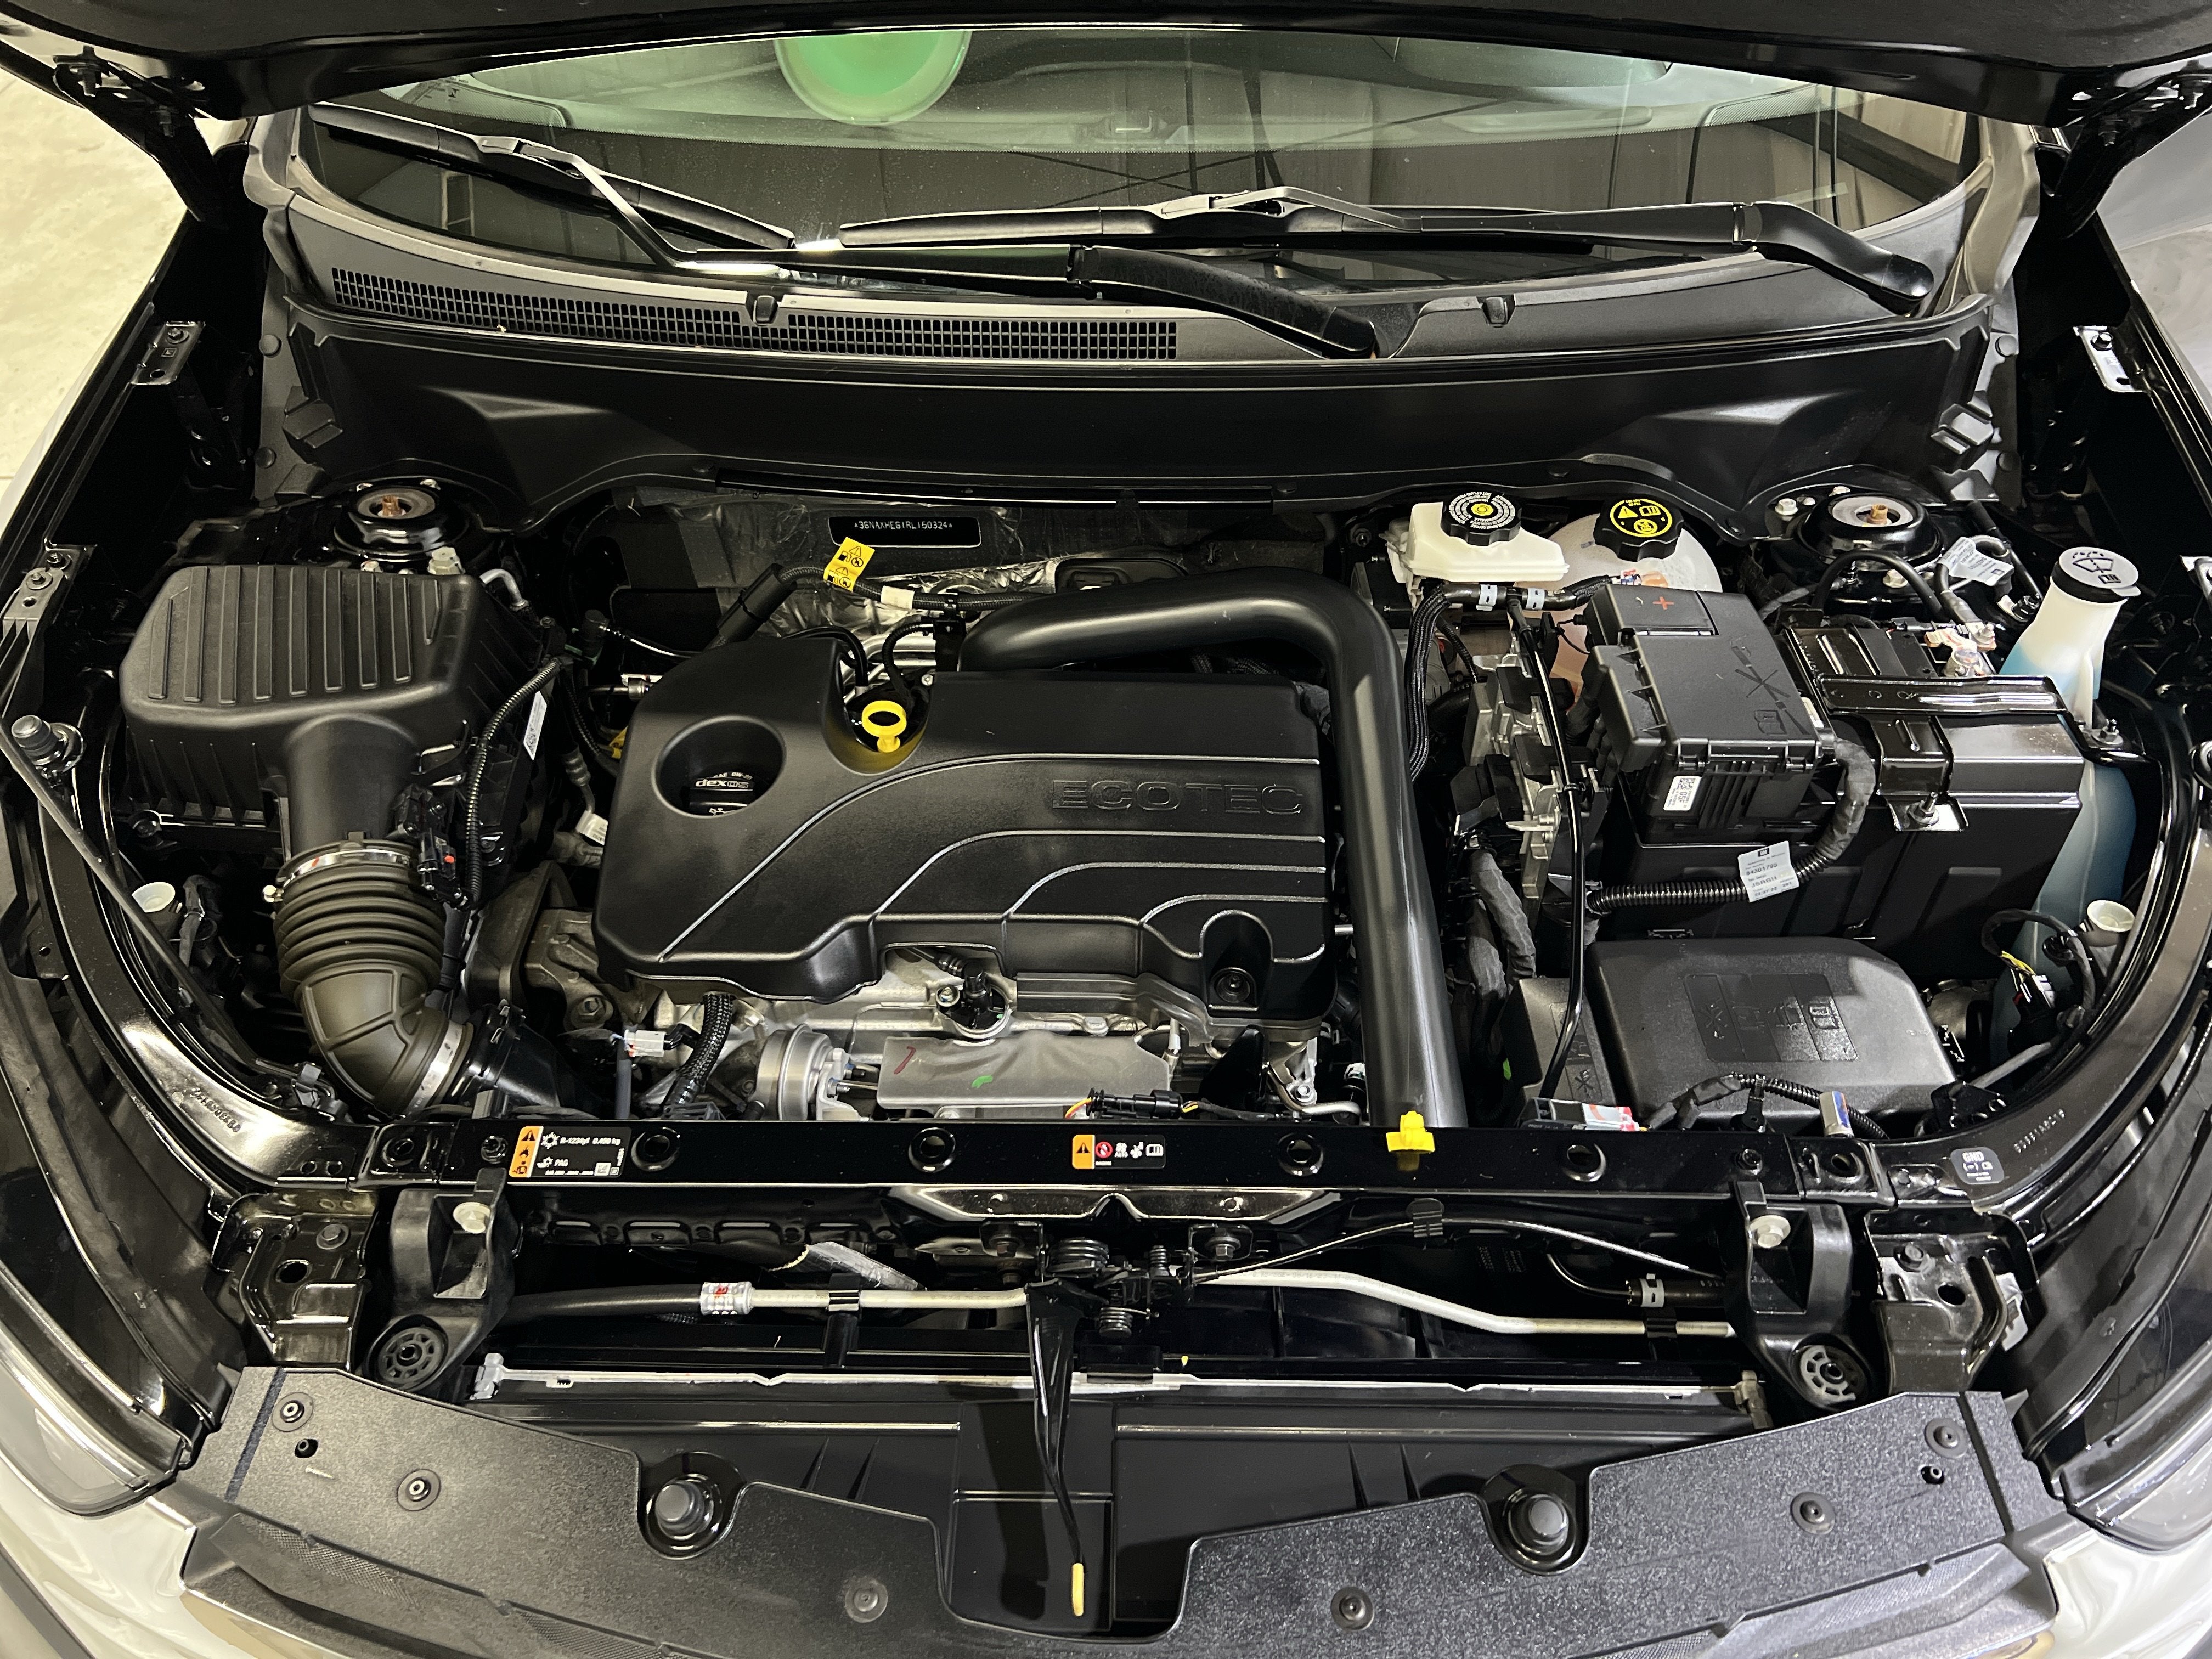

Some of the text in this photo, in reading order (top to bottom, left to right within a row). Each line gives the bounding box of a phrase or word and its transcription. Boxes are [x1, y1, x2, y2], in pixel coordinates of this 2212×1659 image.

[695, 778, 750, 789] dexos
[1052, 780, 1304, 816] ECOTEC
[611, 1137, 621, 1146] kg
[1962, 1151, 1984, 1163] GND
[554, 1159, 569, 1167] PAG
